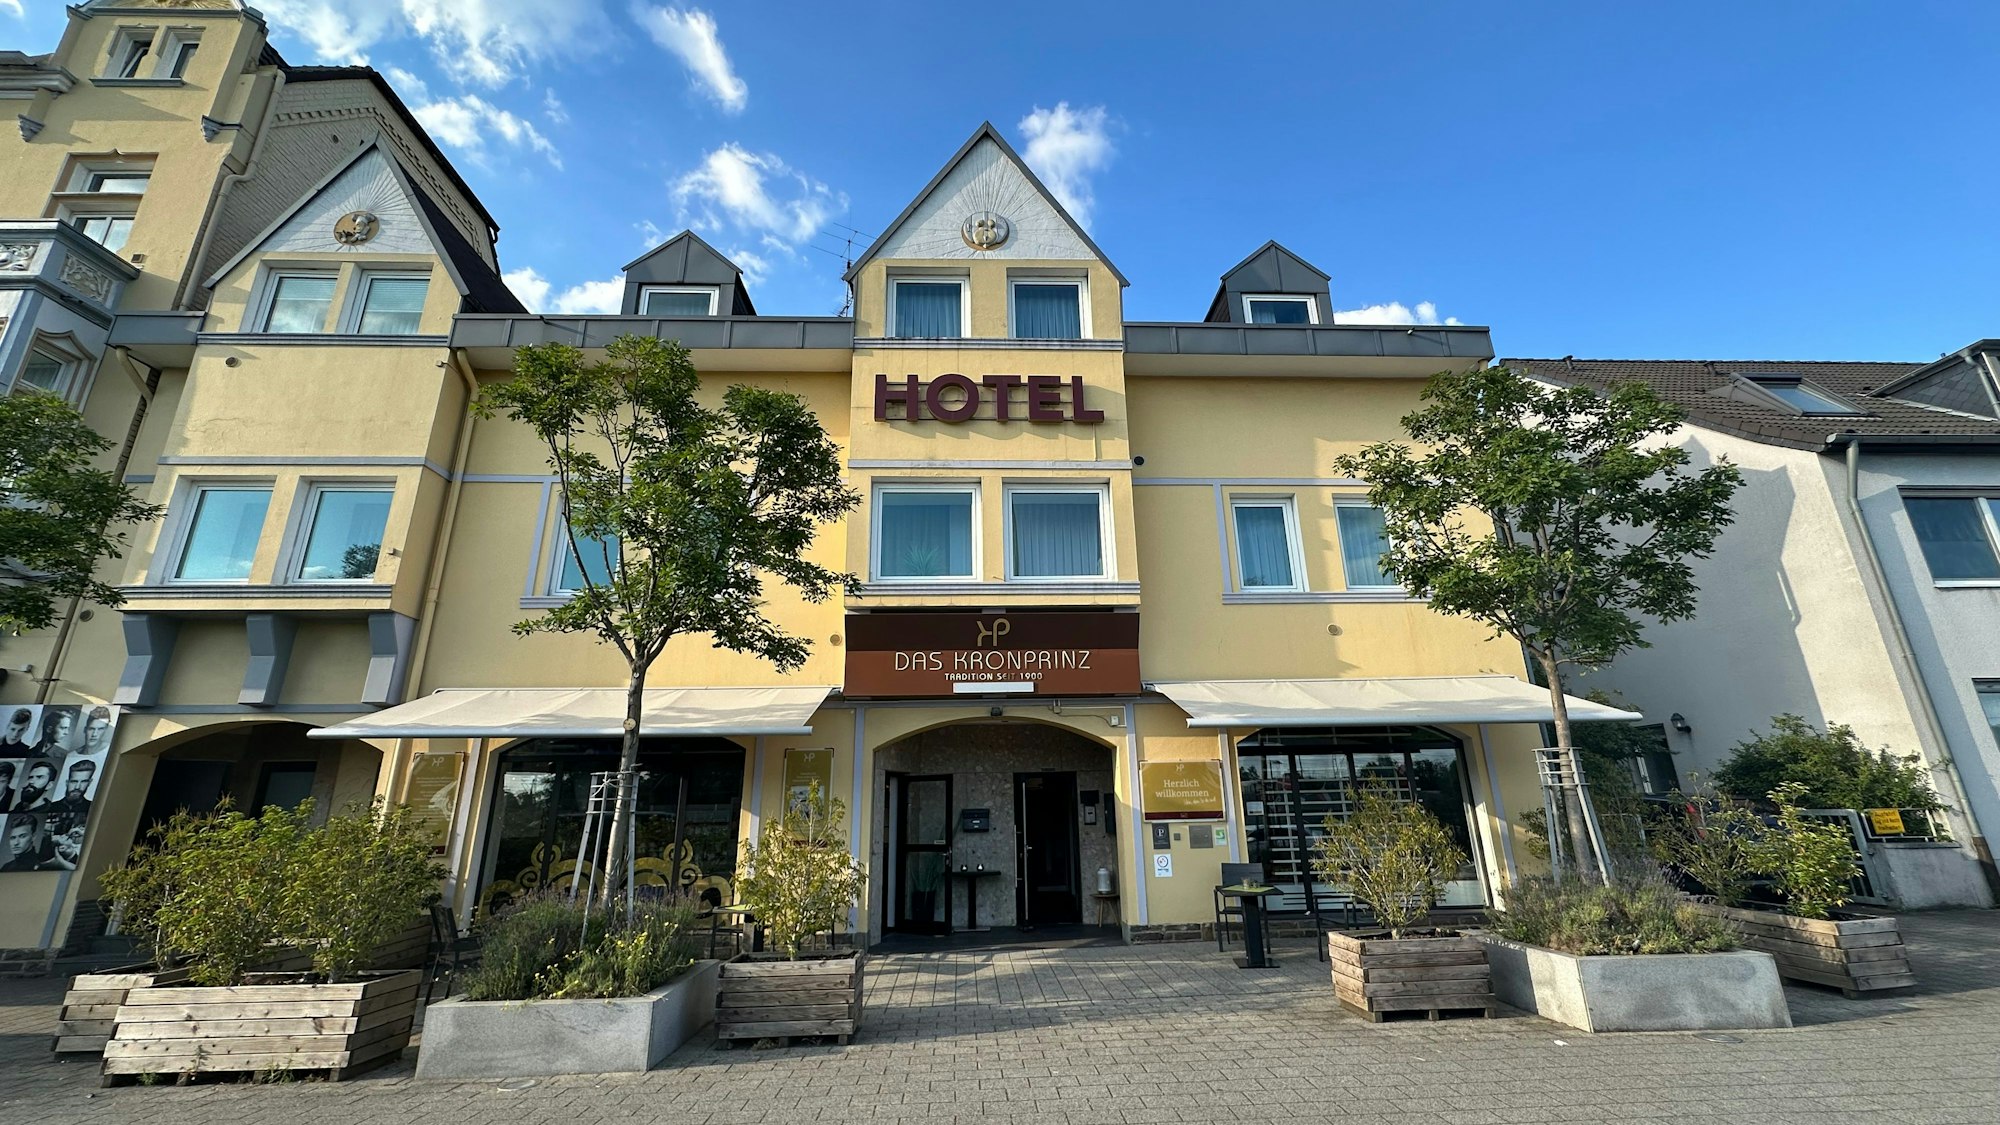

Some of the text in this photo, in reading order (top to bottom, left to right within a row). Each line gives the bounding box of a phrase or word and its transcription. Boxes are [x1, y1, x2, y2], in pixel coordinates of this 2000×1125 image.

[874, 374, 1105, 424] HOTEL
[895, 650, 1091, 671] DAS KRONPRINZ
[944, 672, 1043, 681] TRADITION SEIT 1900
[1163, 779, 1200, 788] Herzlich
[1155, 788, 1209, 798] willkommen
